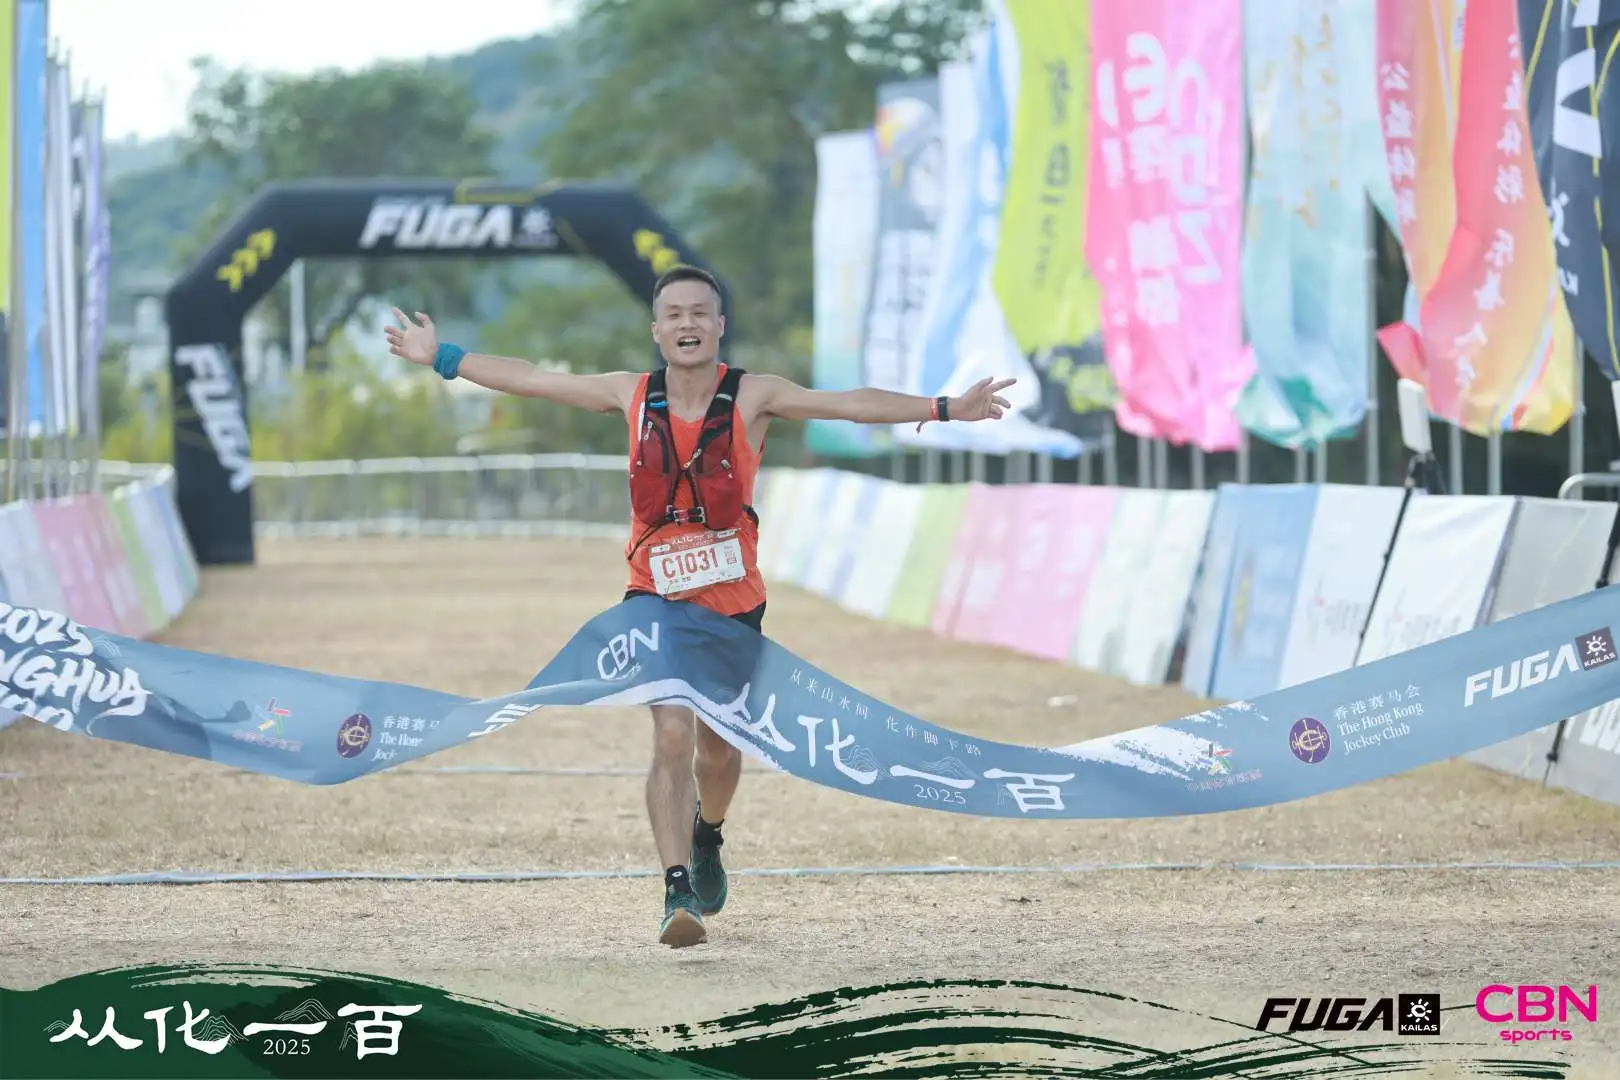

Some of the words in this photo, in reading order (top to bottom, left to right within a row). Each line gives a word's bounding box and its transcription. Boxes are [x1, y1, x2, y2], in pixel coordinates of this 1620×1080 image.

[358, 203, 513, 248] FUGA
[174, 344, 254, 493] FUGA
[661, 547, 719, 579] C1031
[597, 621, 660, 680] CBN
[1464, 643, 1580, 708] FUGA
[1583, 651, 1617, 668] KAILAS
[1333, 683, 1421, 722] 香港赛马会
[1336, 720, 1361, 738] The
[1361, 711, 1394, 731] Hong
[1393, 701, 1425, 720] Kong
[720, 682, 1076, 813] 从化一百
[1343, 731, 1383, 756] Jockey
[1382, 722, 1412, 742] Club
[916, 783, 967, 805] 2025
